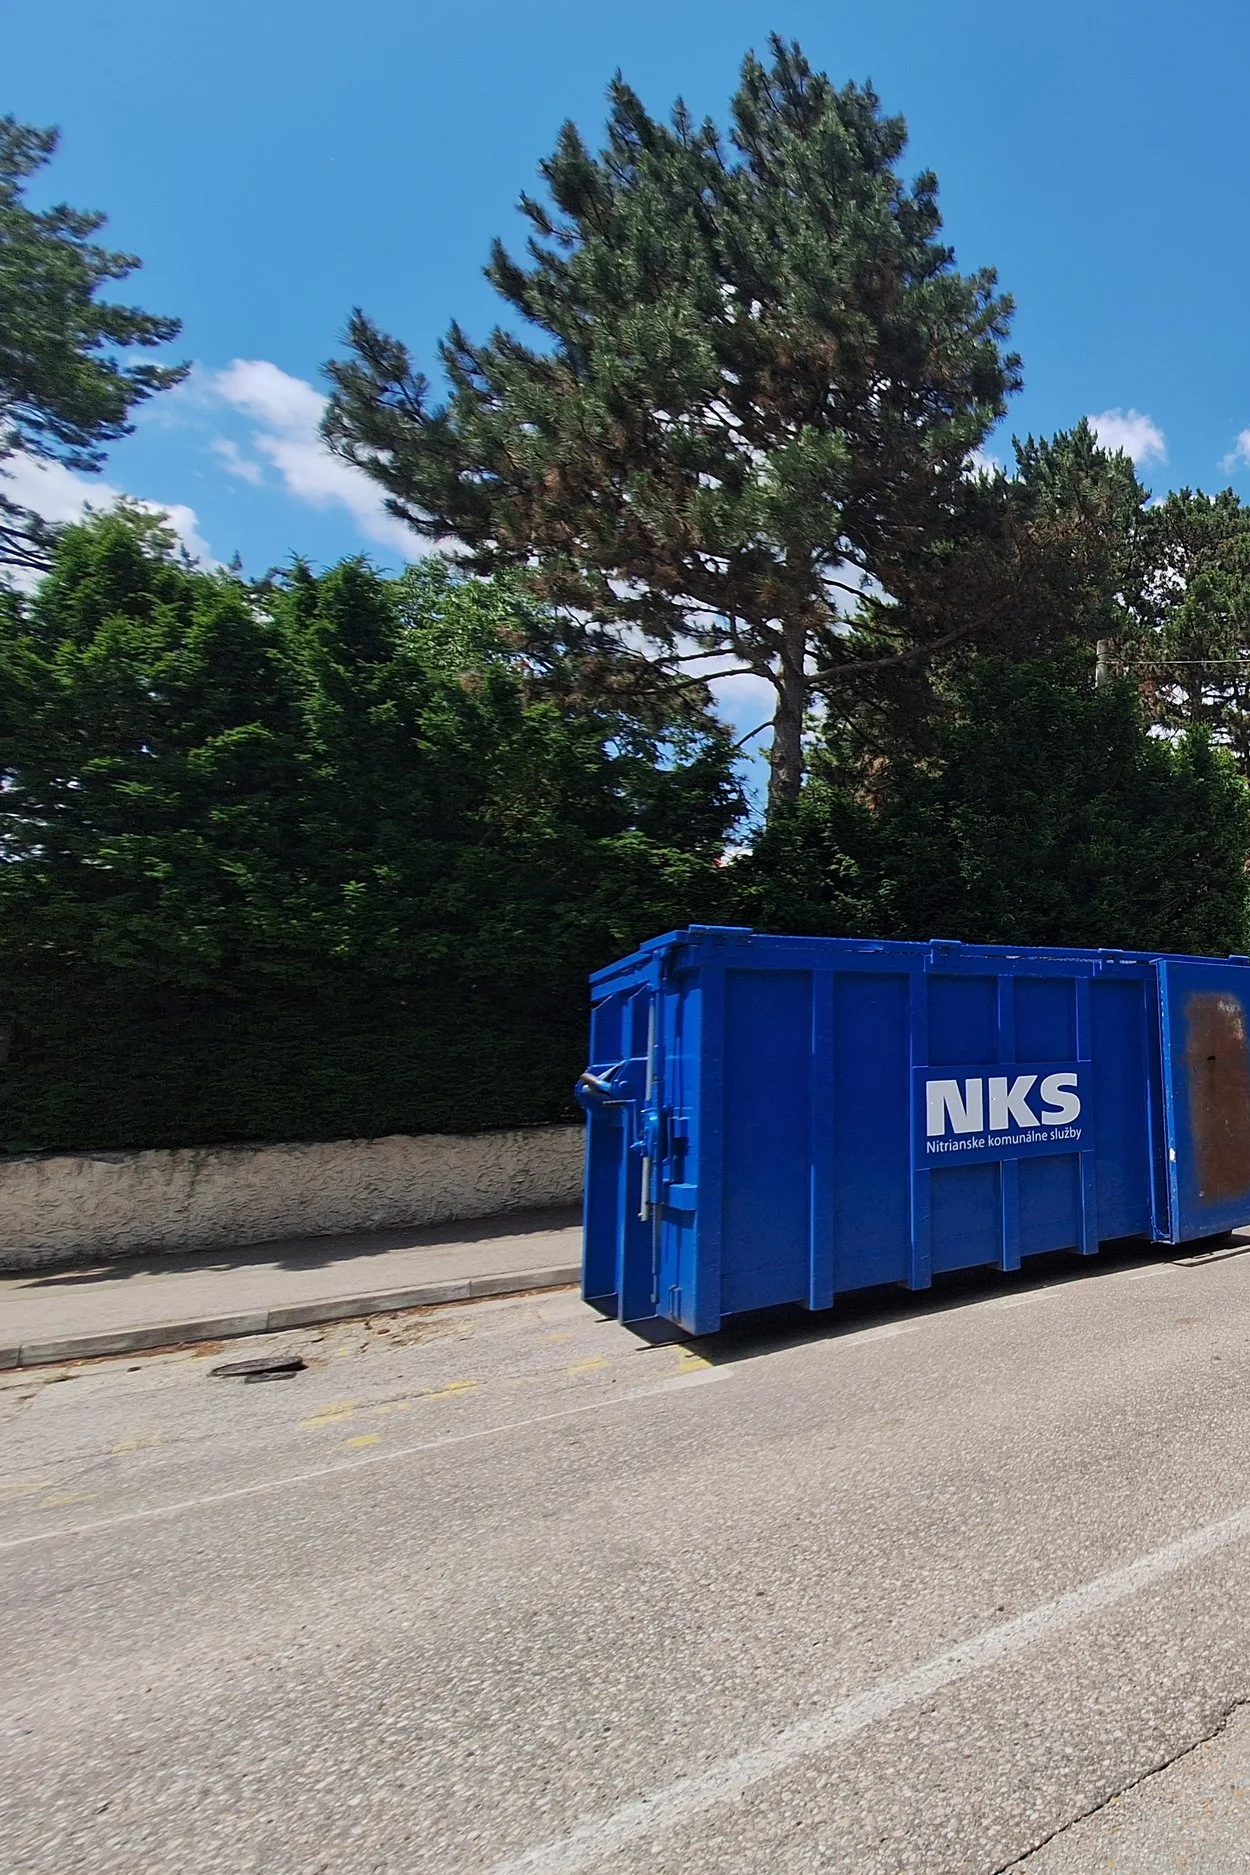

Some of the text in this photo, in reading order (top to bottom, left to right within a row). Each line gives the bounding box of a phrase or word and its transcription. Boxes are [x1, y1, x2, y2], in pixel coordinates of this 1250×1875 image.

[926, 1072, 1081, 1137] NKS
[926, 1127, 1082, 1154] Nitrianske komunálne služby
